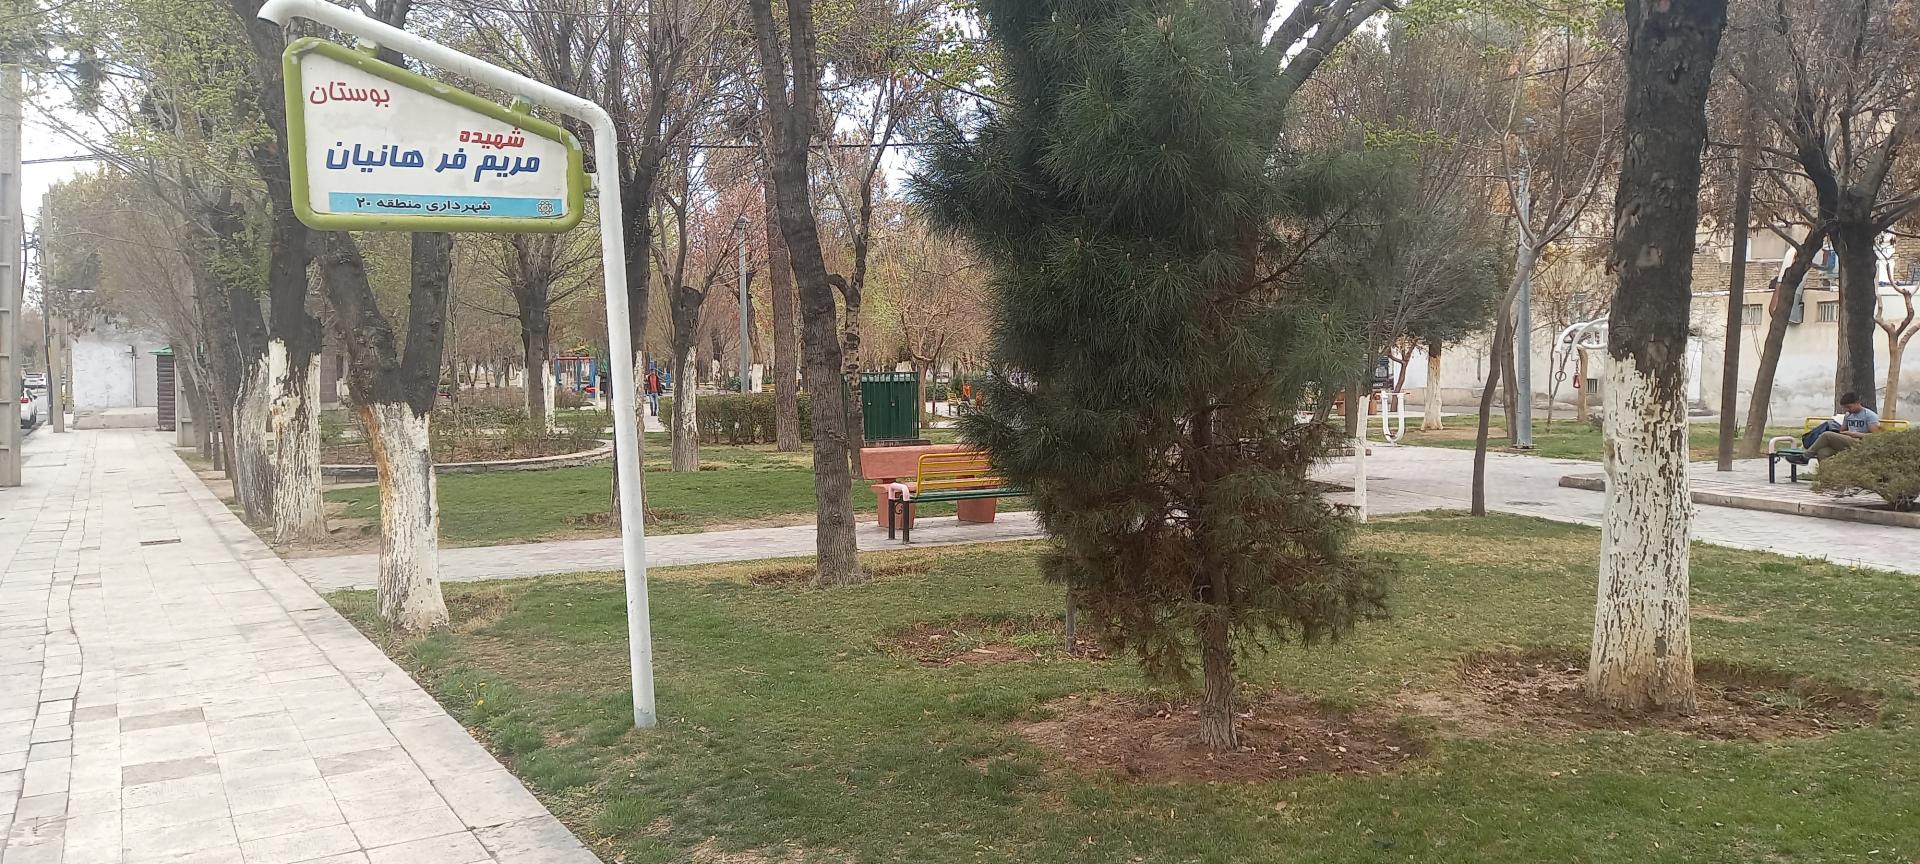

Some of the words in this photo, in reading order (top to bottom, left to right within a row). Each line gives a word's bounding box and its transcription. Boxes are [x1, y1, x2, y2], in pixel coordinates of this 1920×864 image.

[310, 81, 390, 108] بوستان
[459, 127, 525, 149] شهیده
[326, 141, 424, 173] هانیان
[434, 148, 467, 172] فر
[473, 154, 540, 182] مریم
[356, 197, 371, 208] ۲۰
[376, 198, 422, 211] منطقه
[426, 200, 491, 212] شهرداری
